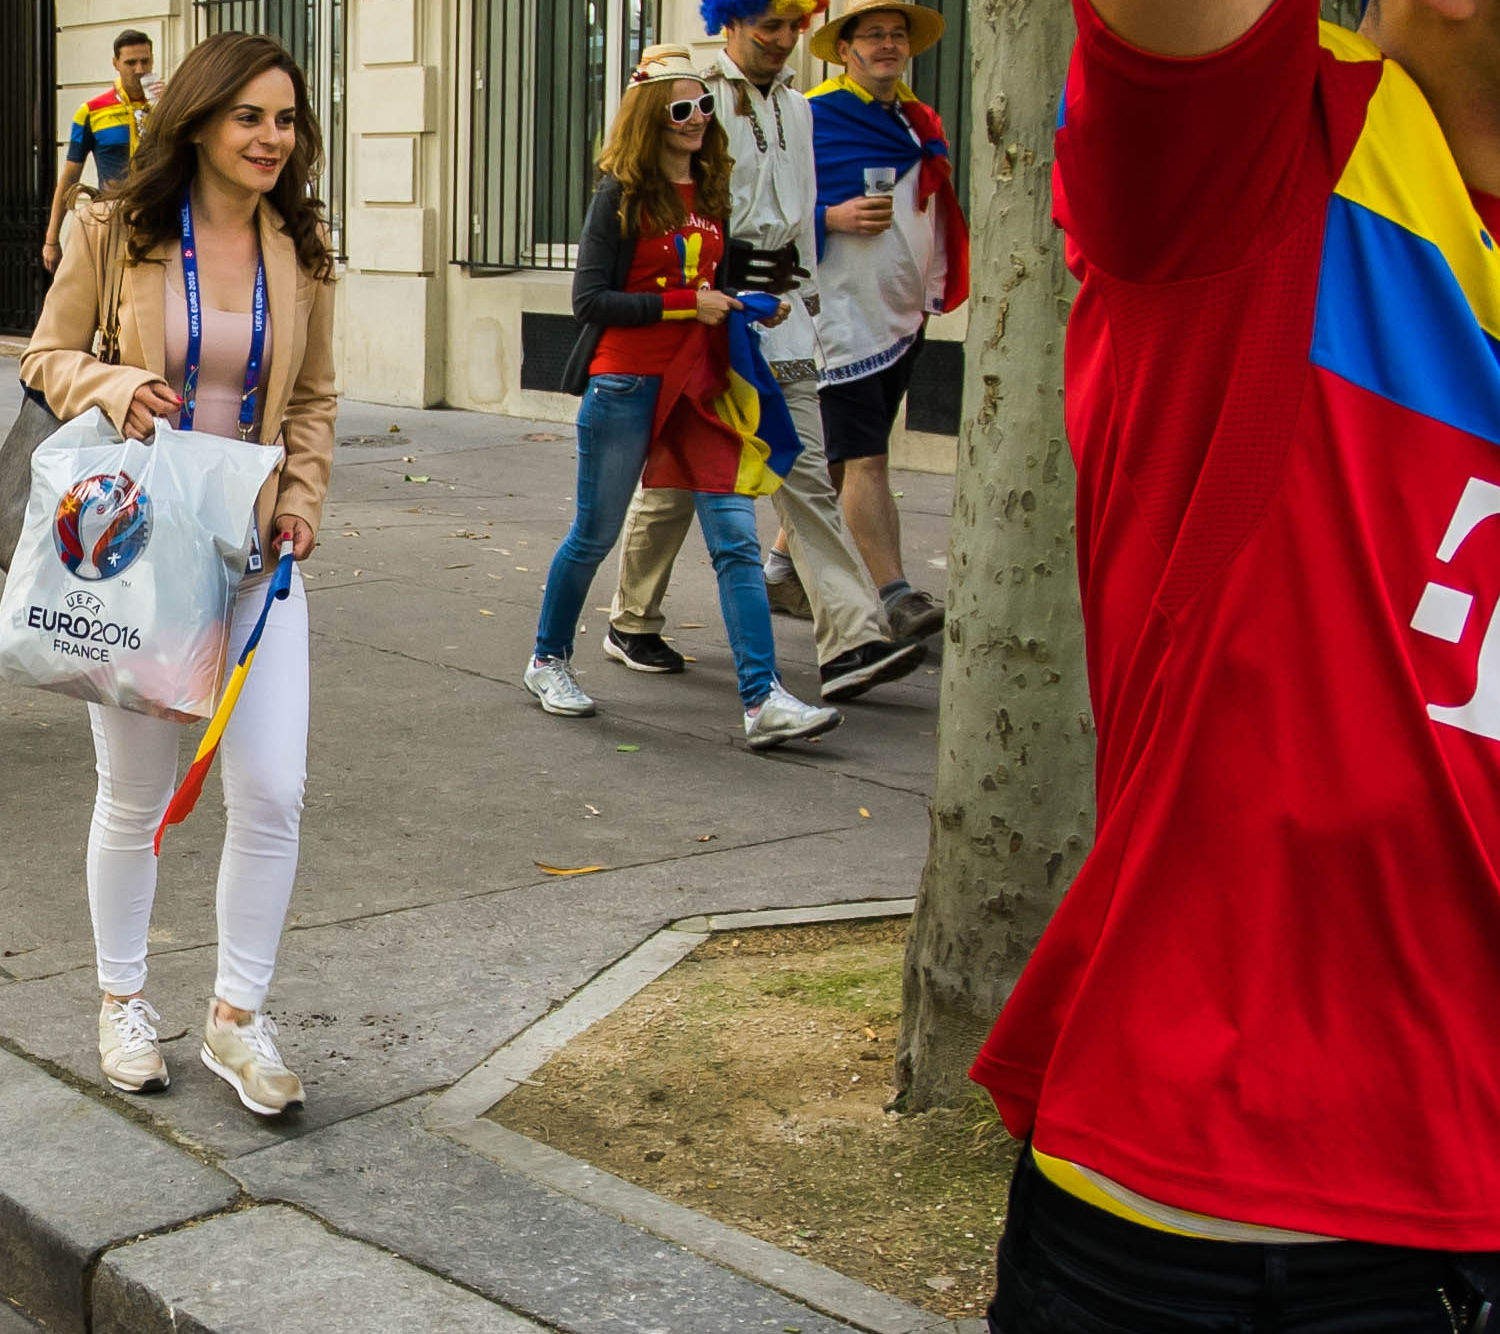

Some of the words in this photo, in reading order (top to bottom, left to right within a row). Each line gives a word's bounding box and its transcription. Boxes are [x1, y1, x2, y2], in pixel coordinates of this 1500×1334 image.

[187, 271, 197, 291] 2016
[189, 291, 199, 314] EURO
[255, 287, 263, 309] EURO
[191, 314, 199, 338] UEFA
[255, 309, 263, 332] UEFA
[66, 594, 100, 614] UEFA
[28, 605, 141, 650] EURO2016
[53, 639, 109, 662] FRANCE
